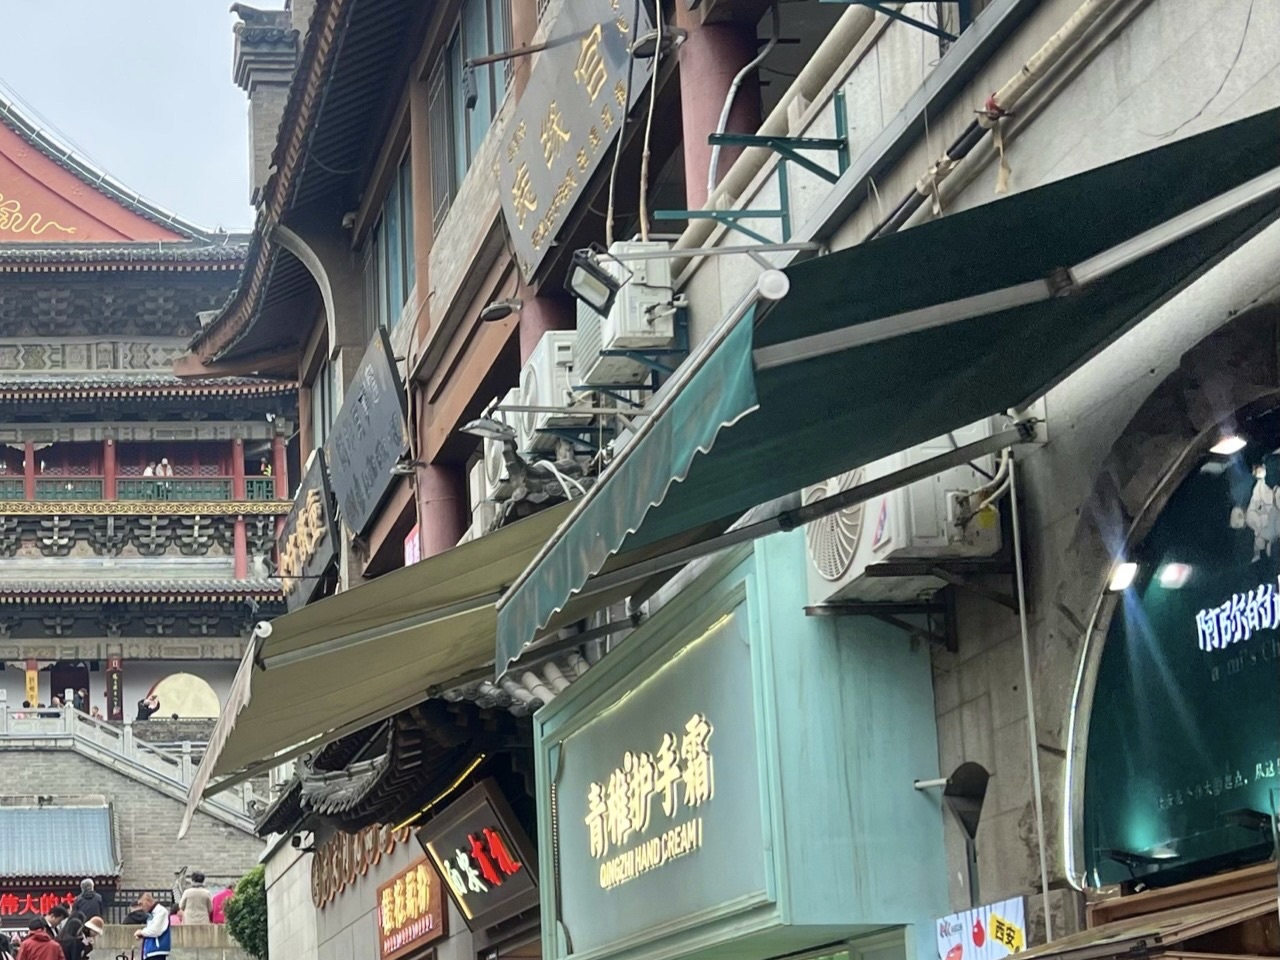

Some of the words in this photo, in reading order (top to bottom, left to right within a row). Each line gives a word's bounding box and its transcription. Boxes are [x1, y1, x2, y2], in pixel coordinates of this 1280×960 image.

[1196, 574, 1280, 652] 阿弥的
[585, 713, 714, 858] 青稚护手霜
[600, 848, 635, 889] QINGZHI
[635, 836, 662, 873] HAND
[662, 818, 697, 862] CREAM
[995, 919, 1015, 948] 西安
